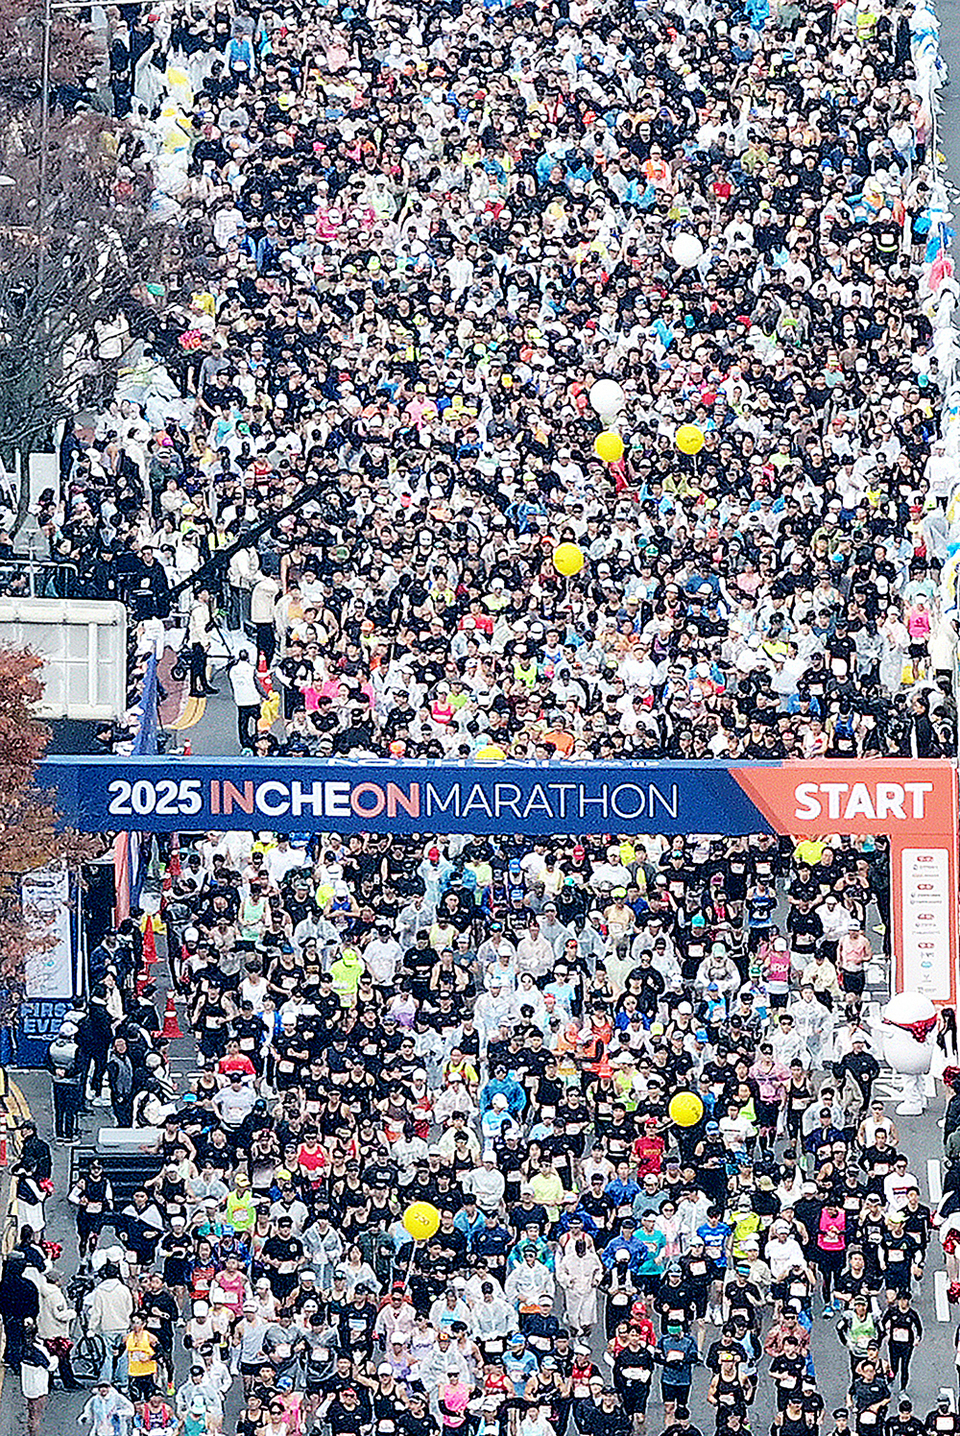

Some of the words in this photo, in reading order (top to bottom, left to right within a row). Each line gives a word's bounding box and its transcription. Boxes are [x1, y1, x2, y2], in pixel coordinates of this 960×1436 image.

[107, 779, 202, 815] 2025
[210, 780, 420, 819] INCHEON
[425, 782, 678, 819] MARATHON
[793, 781, 933, 820] START
[23, 1018, 63, 1033] EVE
